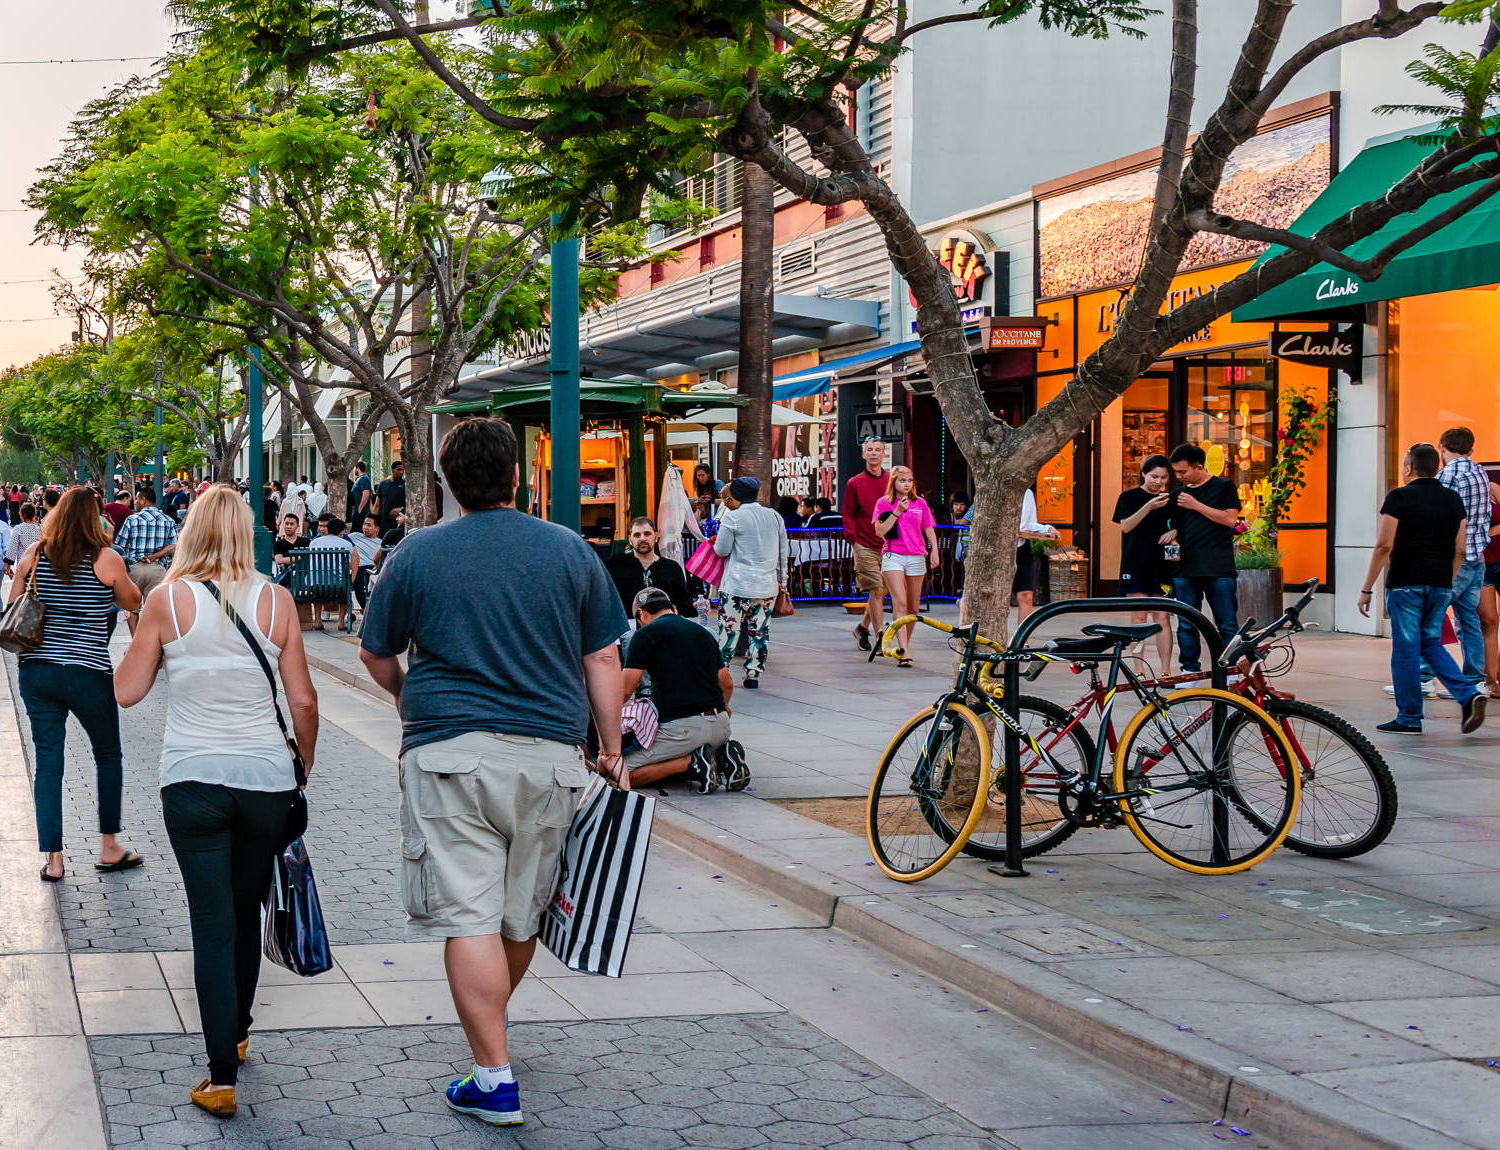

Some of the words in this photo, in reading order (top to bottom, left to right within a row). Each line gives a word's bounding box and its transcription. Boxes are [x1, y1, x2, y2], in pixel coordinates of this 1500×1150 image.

[1316, 278, 1360, 300] Clarks
[962, 308, 980, 321] AFE
[1277, 334, 1353, 356] Clarks
[859, 418, 902, 438] ATM
[772, 455, 815, 477] DESTROY
[777, 477, 810, 496] ORDER
